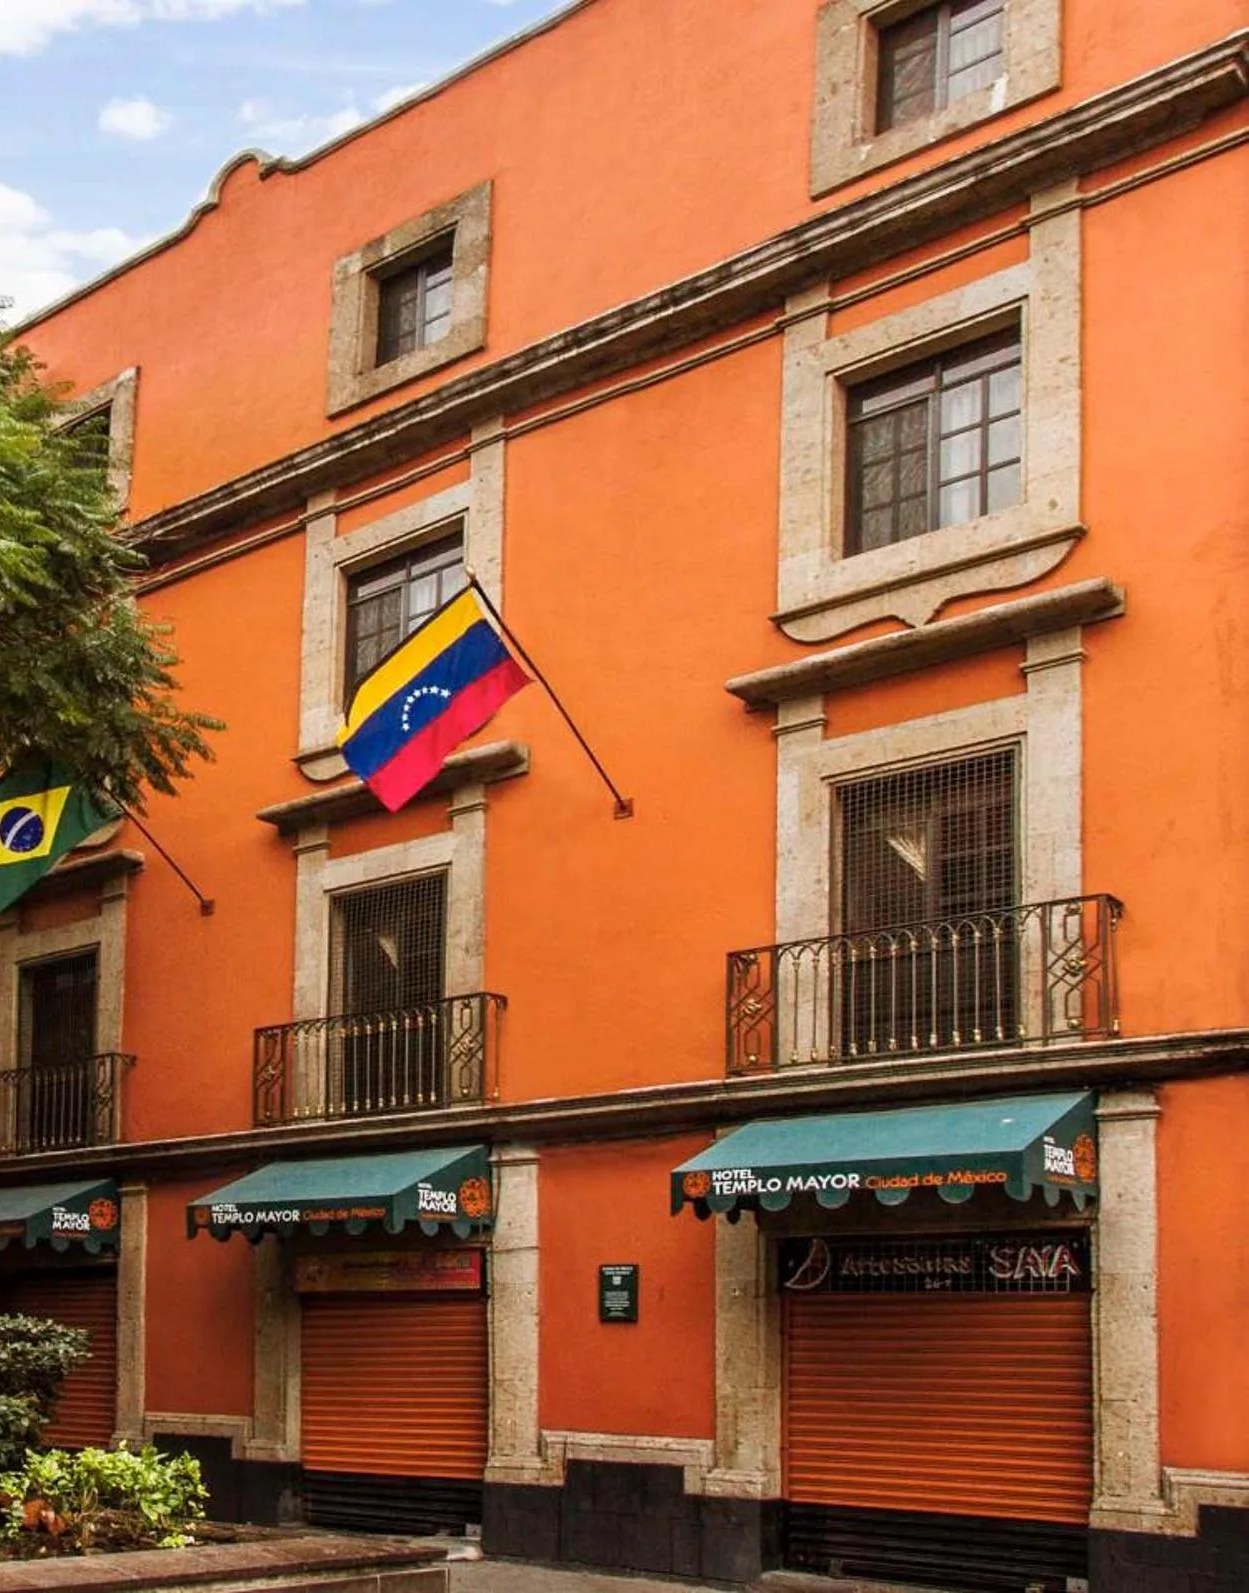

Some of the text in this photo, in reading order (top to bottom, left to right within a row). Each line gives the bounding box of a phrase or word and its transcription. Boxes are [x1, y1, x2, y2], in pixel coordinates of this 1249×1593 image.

[712, 1168, 755, 1180] HOTEL
[712, 1169, 1007, 1195] TEMPLO MAYOR Ciudad de México
[417, 1189, 457, 1203] TEMPLO
[211, 1204, 238, 1212] HOTEL
[418, 1200, 457, 1213] MAYOR
[52, 1212, 90, 1223] TEMPLO
[211, 1211, 254, 1224] TEMPLO
[256, 1209, 300, 1223] MAYOR
[52, 1220, 90, 1231] MAYOR
